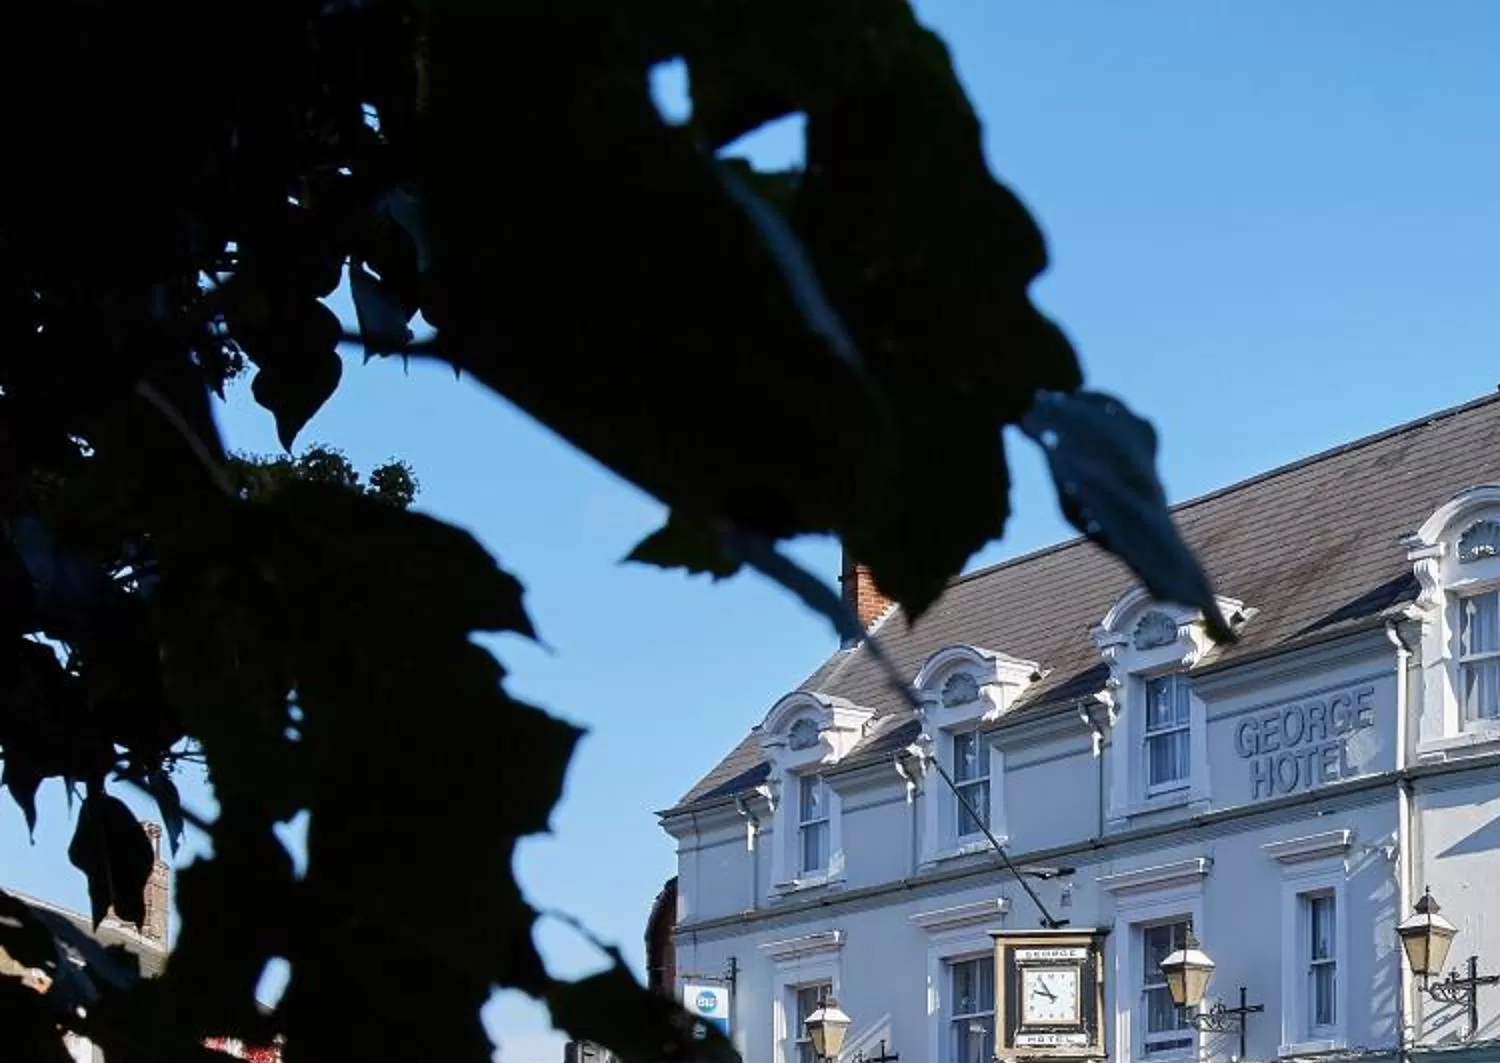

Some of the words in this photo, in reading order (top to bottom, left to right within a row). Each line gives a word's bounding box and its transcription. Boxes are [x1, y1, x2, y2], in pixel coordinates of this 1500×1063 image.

[1234, 687, 1375, 759] GEORGE
[1250, 738, 1359, 799] HOTEL
[1027, 1035, 1075, 1043] HOTEL
